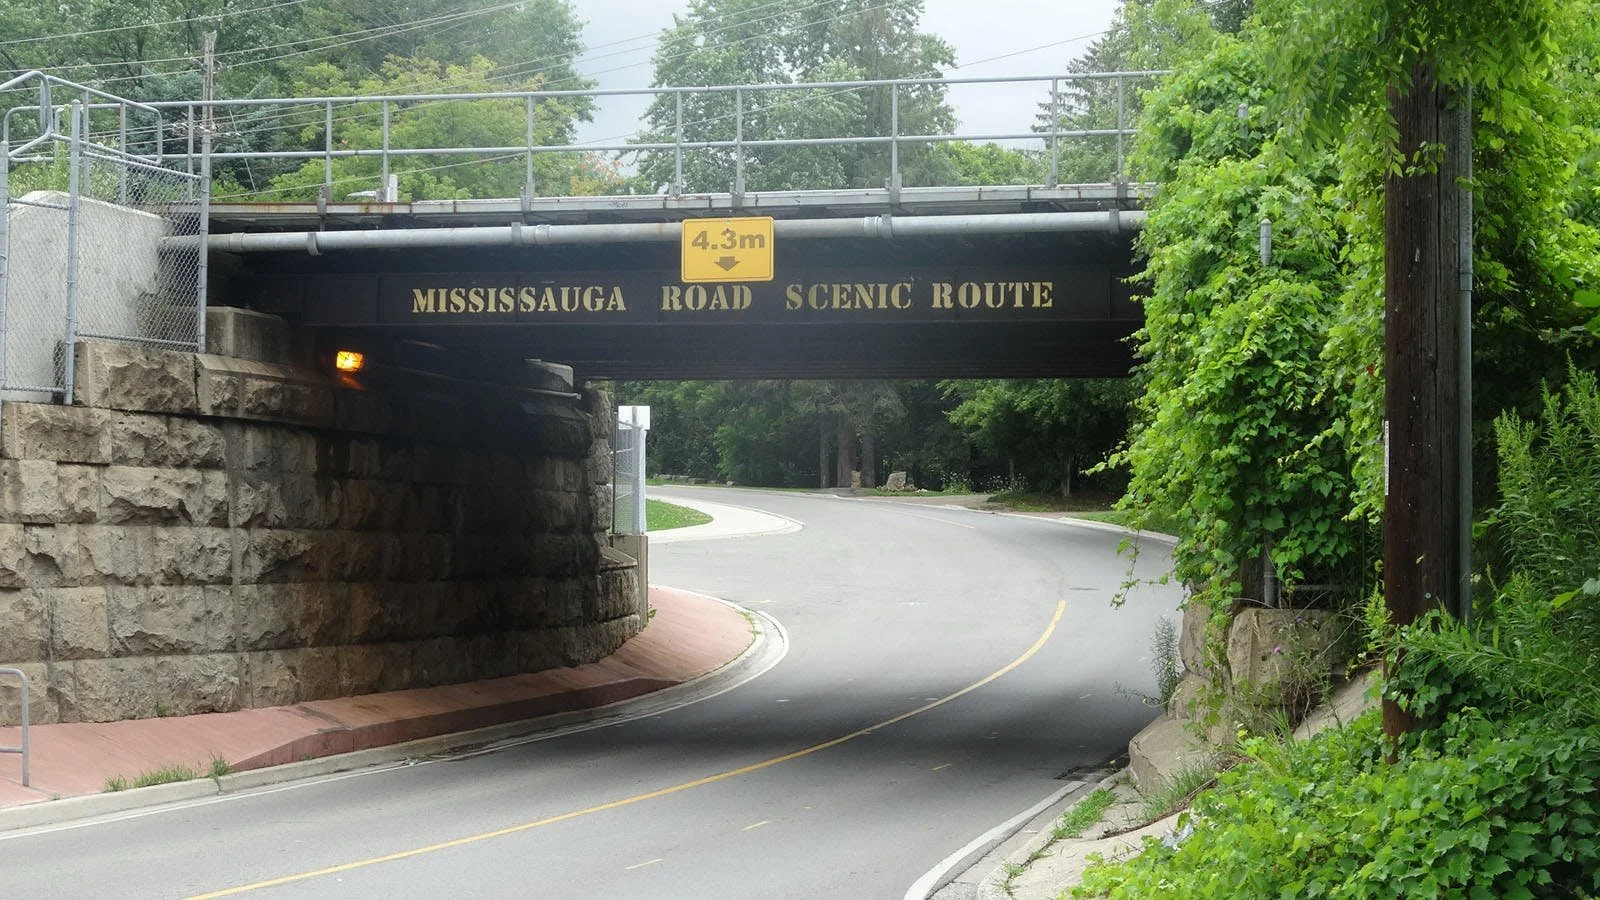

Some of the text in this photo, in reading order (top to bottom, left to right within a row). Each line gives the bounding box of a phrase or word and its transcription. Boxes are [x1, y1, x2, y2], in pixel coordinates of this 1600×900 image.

[691, 229, 766, 250] 4.3m
[412, 281, 1054, 313] MISSISSAUGA ROAD SCENIC ROUTE
